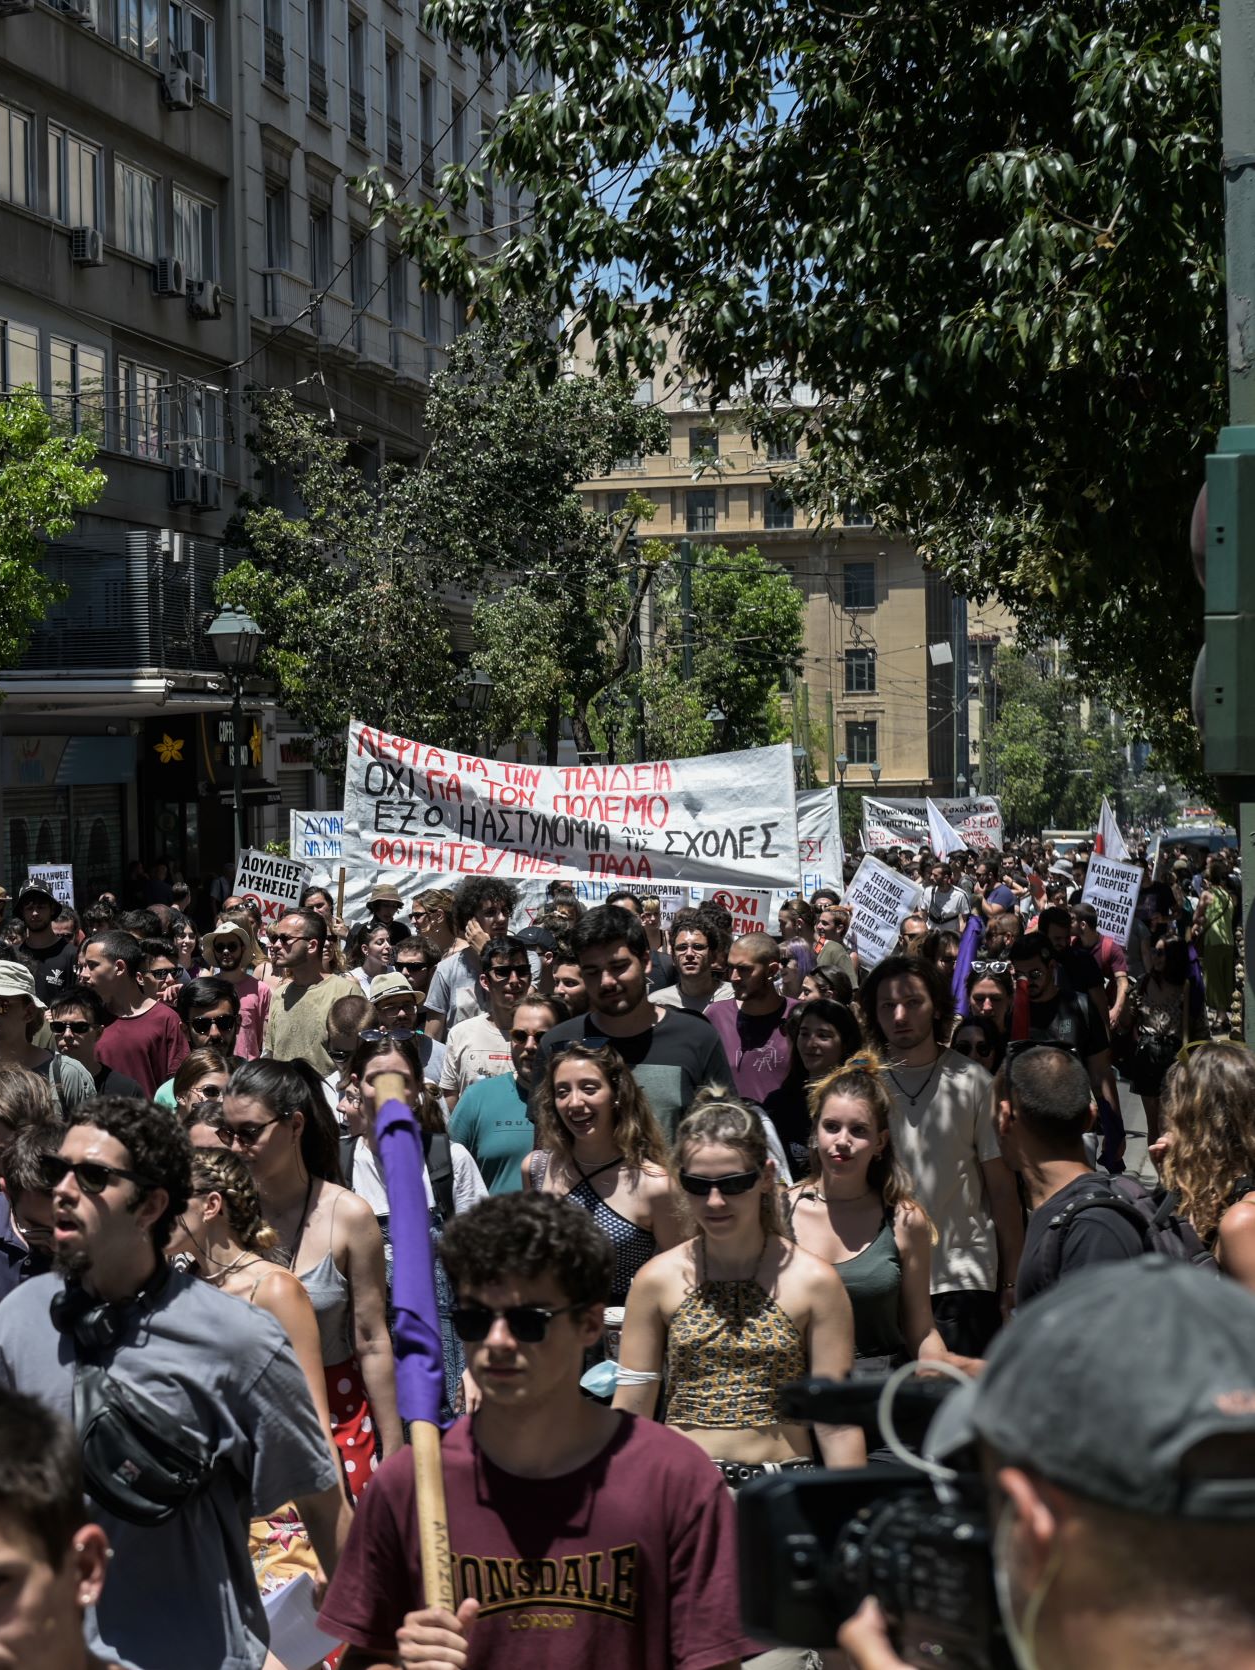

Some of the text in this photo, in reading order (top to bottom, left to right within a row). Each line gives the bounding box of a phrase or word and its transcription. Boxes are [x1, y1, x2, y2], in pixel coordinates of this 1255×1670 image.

[357, 726, 674, 792] ΛΕΦΤΑ ΓΙΑ ΤΗΝ ΠΑΙΔΕΙΑ
[366, 761, 670, 829] ΟΧΙ ΓΙΑ ΤΟΝ ΠΟΛΕΜΟ
[458, 805, 477, 842] Η
[481, 809, 612, 853] ΑΣΤΥΝΟΜΙΑ
[665, 821, 781, 860] ΣΧΟΛΕΣ
[305, 840, 320, 856] ΝΑ
[241, 855, 302, 882] ΔΟΥΛΕΙΕΣ
[588, 853, 653, 881] ΠΑΔΑ
[1091, 863, 1139, 884] ΚΑΤΑΛΗΨΕΙΣ
[238, 872, 299, 900] ΑΥΞΗΣΕΙΣ
[627, 884, 681, 896] ΤΡΟΜΟΚΡΑΤΙΑ
[862, 881, 901, 912] ΡΑΤΣΙΣΜΟΣ
[870, 871, 905, 900] ΣΕΞΙΣΜΟΣ
[1094, 876, 1130, 894] ΑΠΕΡΓΙΕΣ
[852, 888, 899, 927] ΤΡΟΜΟΚΡΑΤΙΑ
[1091, 896, 1130, 916] ΔΗΜΟΣΙΑ
[1119, 895, 1133, 907] ΓΙΑ
[855, 909, 876, 929] ΚΑΤΩ
[1097, 920, 1126, 936] ΑΙΔΕΙΑ
[850, 921, 886, 949] ΔΗΜΟΚΡΑΤΙΑ
[508, 1613, 576, 1630] LONDON
